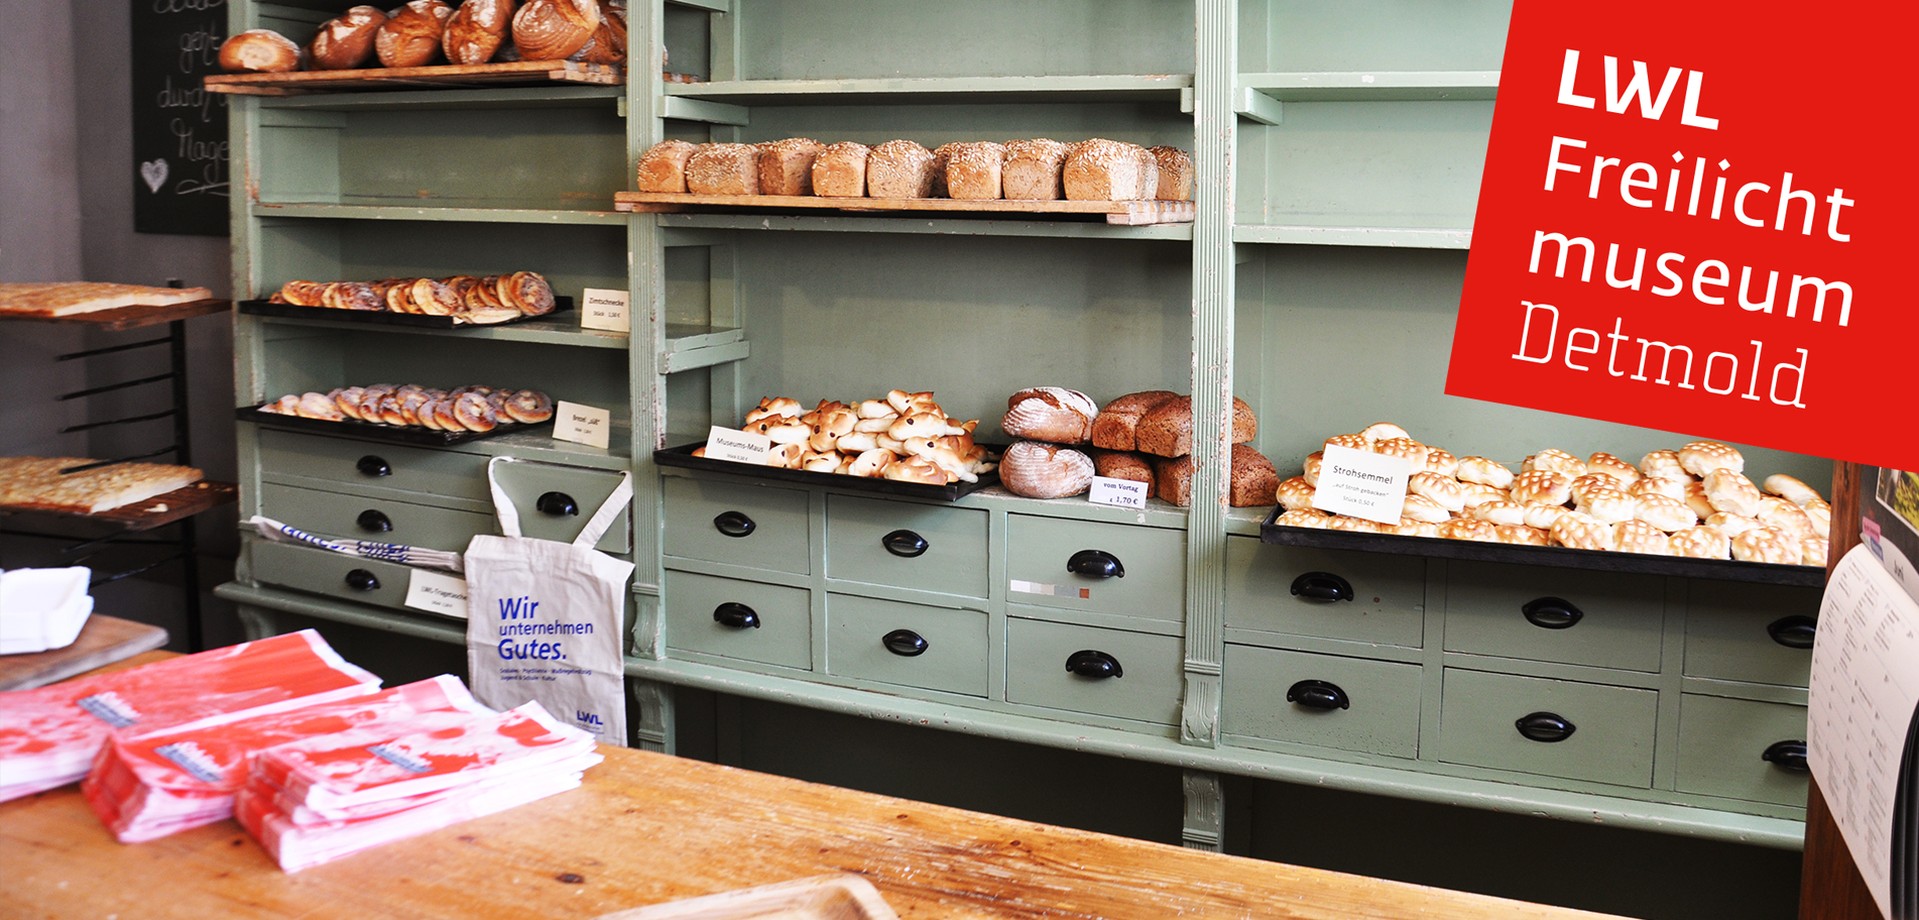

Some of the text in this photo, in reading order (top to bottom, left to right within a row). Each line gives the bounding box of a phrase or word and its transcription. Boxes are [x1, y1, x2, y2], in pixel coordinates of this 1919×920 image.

[589, 297, 624, 307] Zimtschnecke
[716, 438, 764, 452] Museums-Maus
[1333, 465, 1393, 484] Strohsemmel
[1118, 484, 1139, 493] Vortag
[1345, 484, 1360, 492] Stroh
[1117, 496, 1132, 504] 1,70
[1343, 495, 1357, 504] Stück
[498, 595, 539, 620] Wir
[500, 619, 593, 636] unternehmen
[498, 639, 567, 660] Gutes.
[576, 710, 604, 725] LWL
